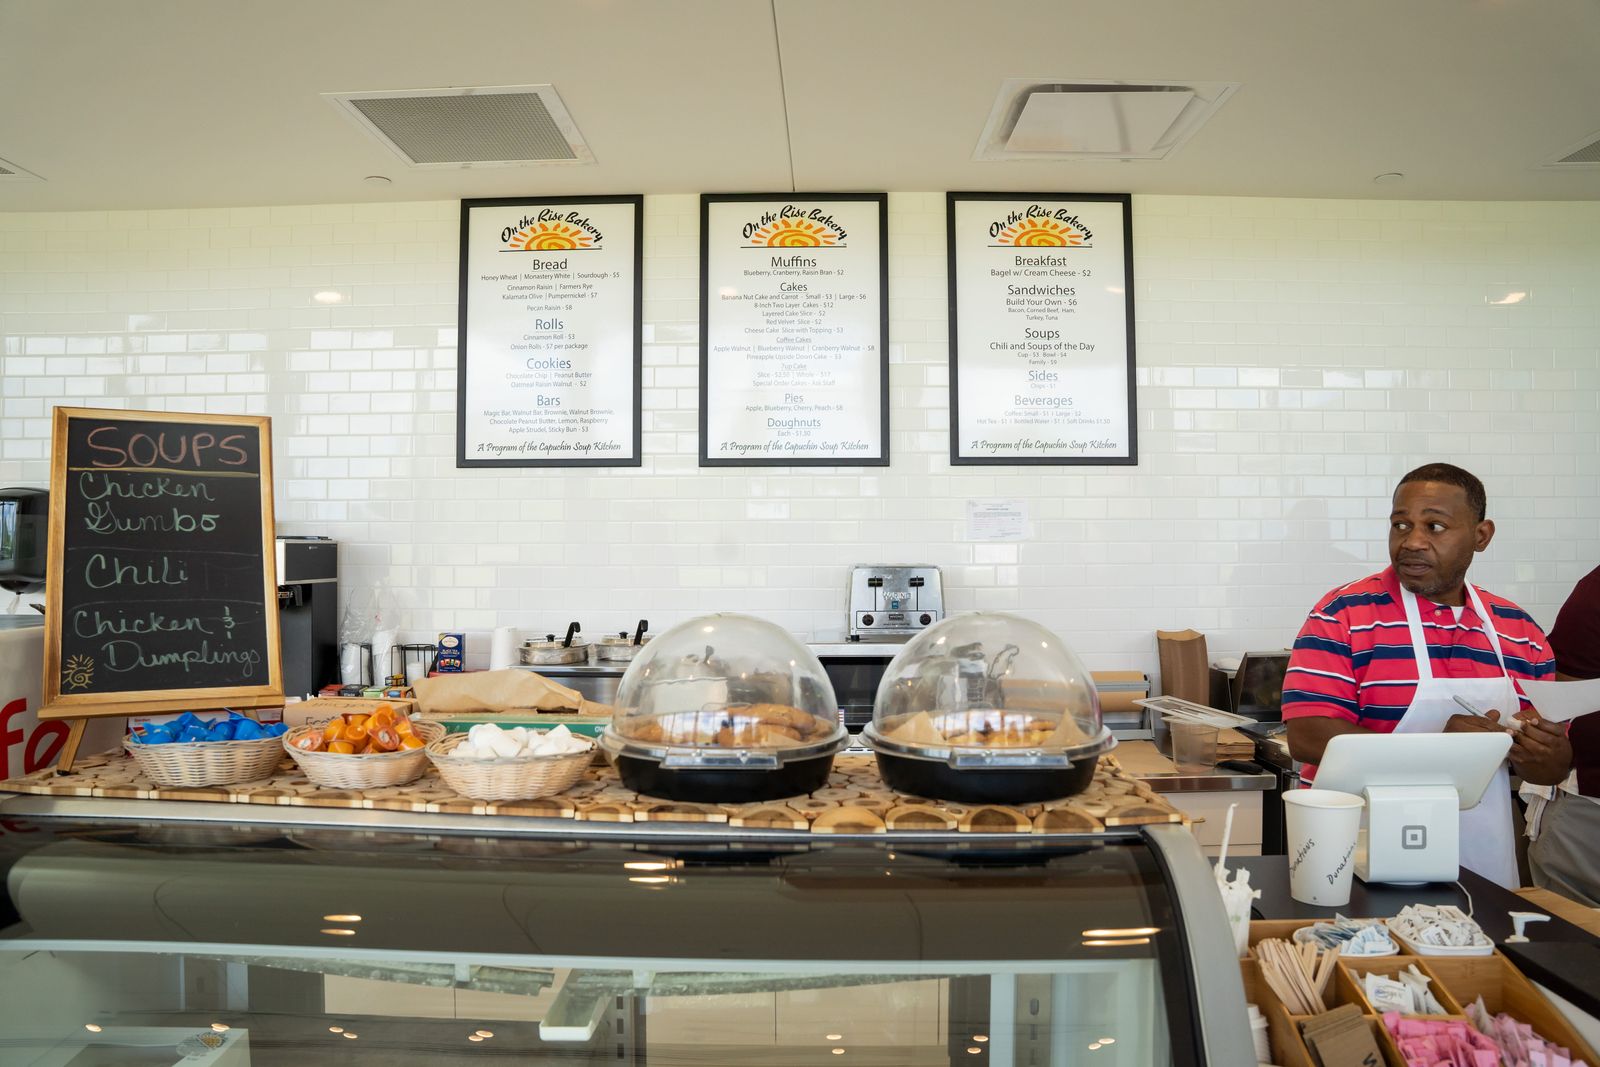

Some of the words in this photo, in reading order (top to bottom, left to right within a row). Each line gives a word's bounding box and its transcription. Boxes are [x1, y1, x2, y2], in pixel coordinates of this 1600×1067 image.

[502, 227, 518, 242] On
[519, 216, 534, 229] the
[538, 209, 563, 222] Rise
[565, 212, 602, 243] Bakery
[743, 223, 759, 239] On
[761, 212, 777, 226] the
[780, 205, 806, 218] Rise
[808, 209, 847, 240] Bakery
[990, 222, 1006, 238] On
[1008, 212, 1022, 226] the
[1026, 205, 1052, 218] Rise
[1054, 209, 1092, 241] Bakery
[533, 259, 567, 270] Bread
[771, 256, 816, 267] Muffins
[1016, 256, 1066, 266] Breakfast
[991, 270, 1011, 278] Bagel
[780, 282, 807, 292] Cakes
[1008, 285, 1075, 295] Sandwiches
[535, 319, 563, 330] Rolls
[1025, 328, 1060, 341] Soups
[990, 342, 1008, 350] Chili
[1010, 342, 1025, 350] and
[1027, 342, 1053, 352] Soups
[1054, 342, 1061, 350] of
[1063, 342, 1078, 350] the
[1079, 342, 1095, 352] Day
[527, 358, 571, 369] Cookies
[1028, 370, 1058, 381] Sides
[537, 395, 560, 406] Bars
[785, 393, 803, 403] Pies
[1014, 395, 1072, 407] Beverages
[768, 418, 821, 429] Doughnuts
[87, 427, 248, 468] SOUPS
[478, 443, 485, 452] A
[486, 443, 517, 456] Program
[519, 442, 527, 453] of
[527, 441, 537, 451] the
[539, 442, 571, 455] Capuchin
[573, 442, 591, 454] Soup
[593, 440, 621, 450] Kitchen
[721, 442, 728, 450] A
[730, 442, 761, 455] Program
[763, 440, 771, 452] of
[772, 440, 782, 450] the
[784, 441, 817, 454] Capuchin
[820, 442, 838, 454] Soup
[840, 440, 868, 450] Kitchen
[971, 441, 978, 450] A
[980, 441, 1012, 453] Program
[1014, 440, 1022, 451] of
[1023, 439, 1032, 448] the
[1035, 440, 1067, 452] Capuchin
[1069, 441, 1087, 452] Soup
[1089, 439, 1117, 449] Kitchen
[80, 472, 215, 501] Chicken
[84, 501, 220, 535] Gumbo
[74, 610, 214, 638] Chicken
[102, 640, 260, 677] Dumplings
